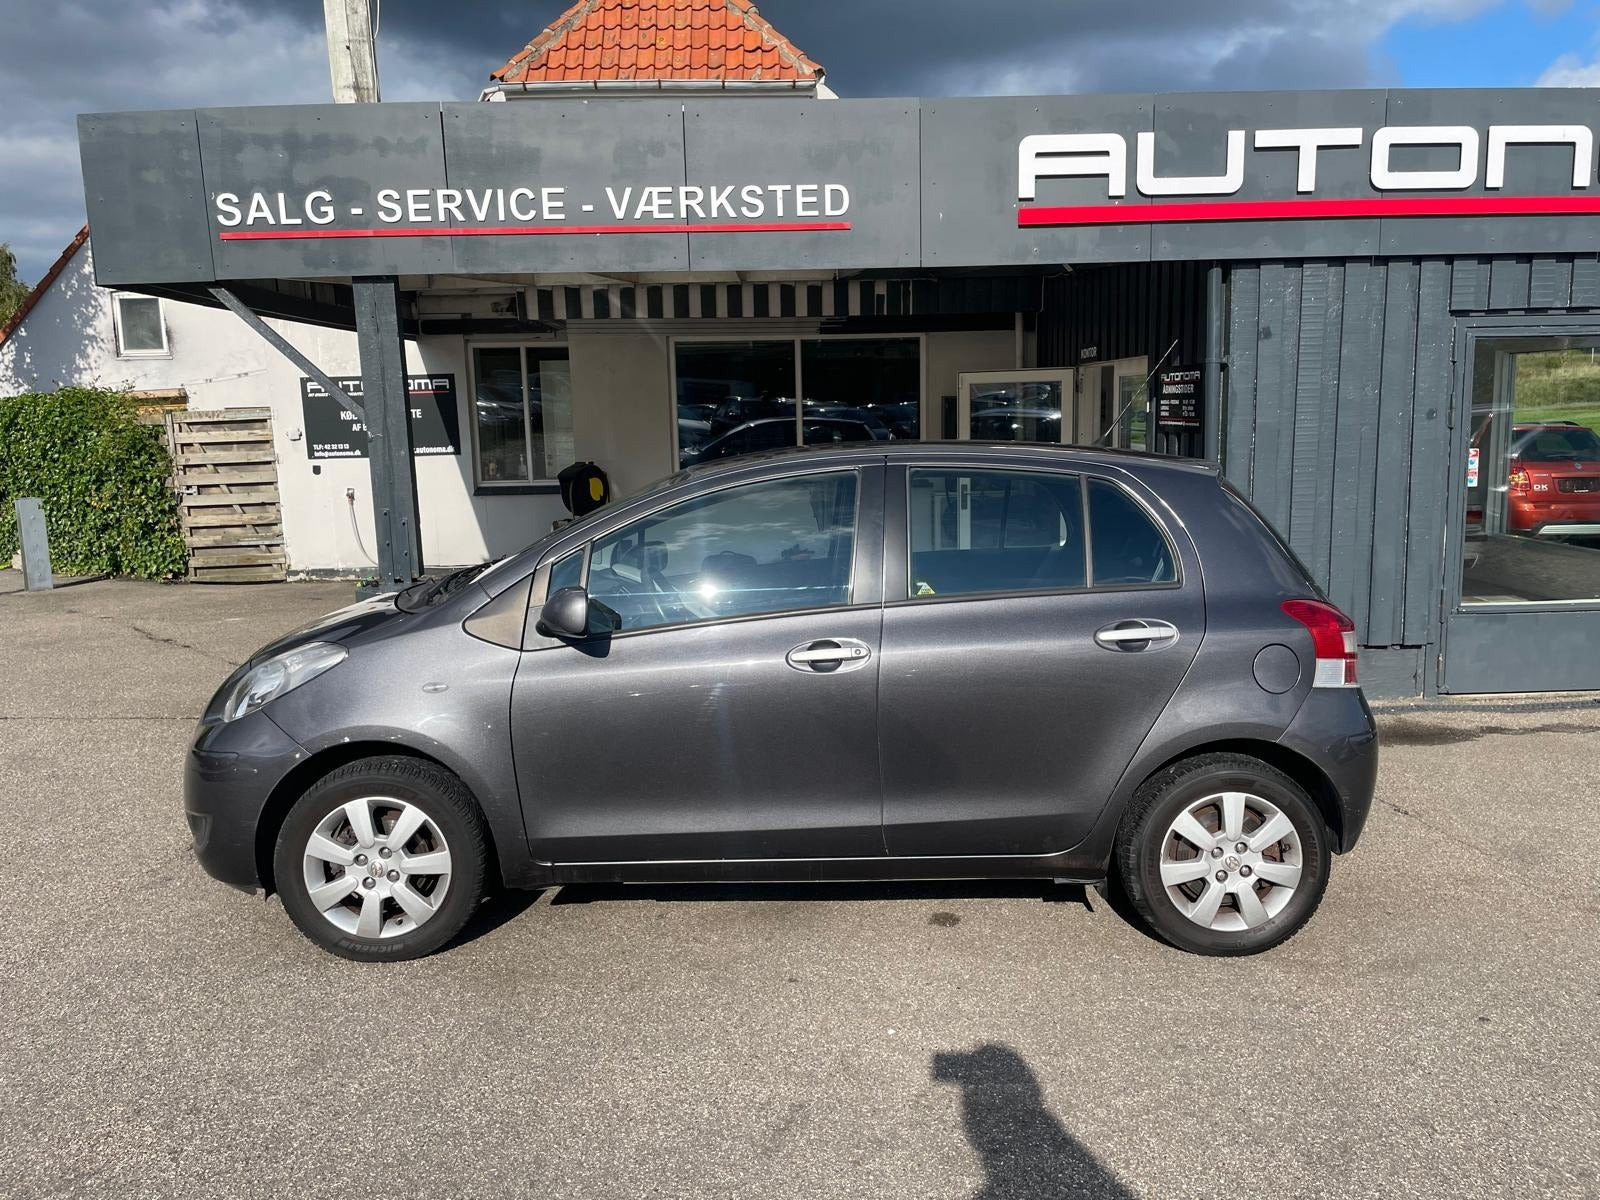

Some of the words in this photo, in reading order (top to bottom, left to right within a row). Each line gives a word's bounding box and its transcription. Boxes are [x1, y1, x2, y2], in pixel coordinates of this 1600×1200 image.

[1018, 125, 1600, 199] AUTON
[216, 190, 335, 227] SALG
[377, 187, 566, 223] SERVICE
[605, 183, 850, 220] VÆRKSTED
[413, 445, 455, 454] .autonoma.dk
